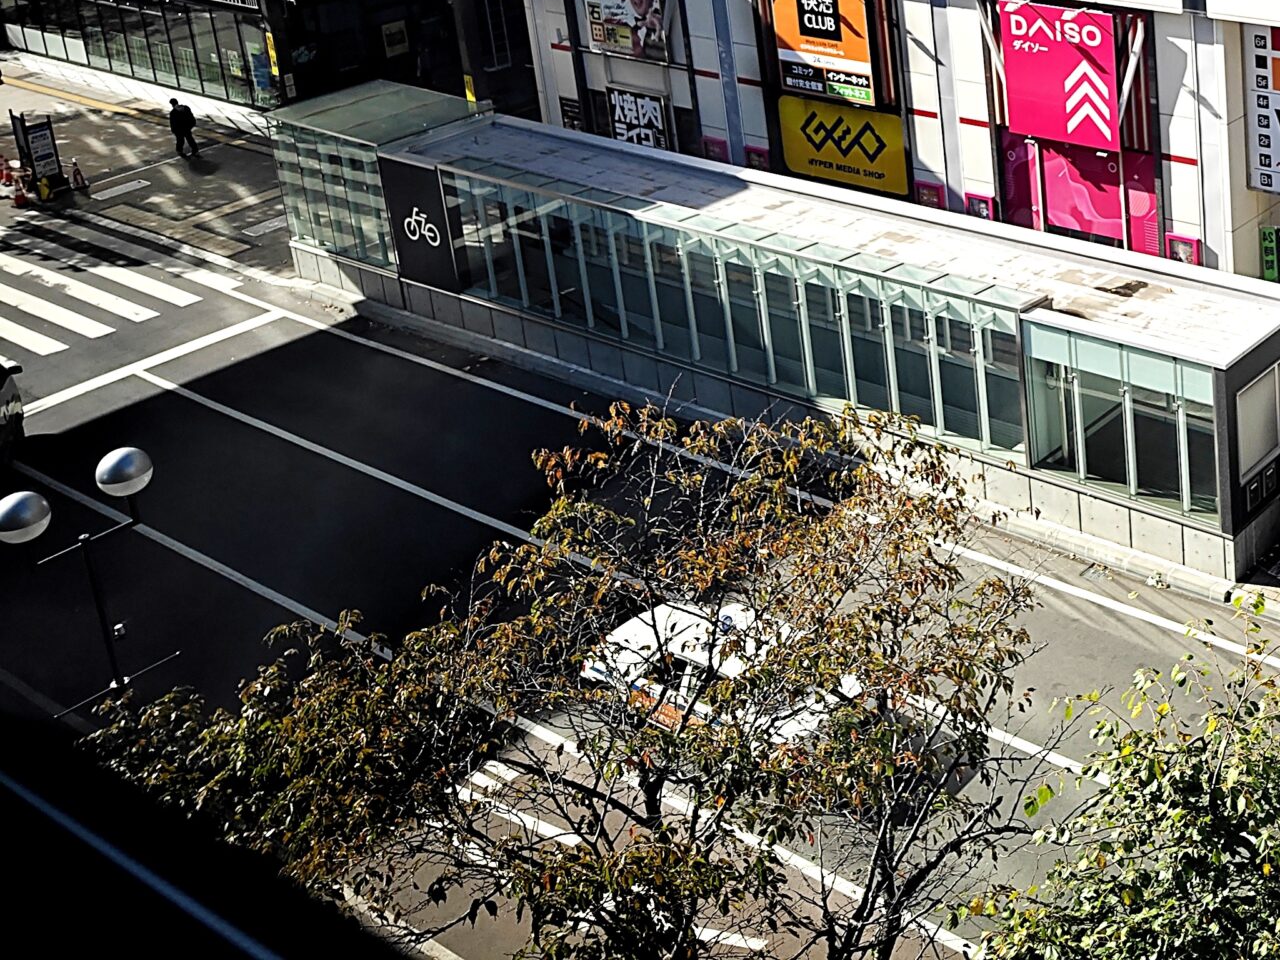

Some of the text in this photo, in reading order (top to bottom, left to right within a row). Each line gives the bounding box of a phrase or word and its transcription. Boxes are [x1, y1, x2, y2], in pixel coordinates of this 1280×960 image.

[803, 13, 836, 31] CLUB
[1009, 13, 1103, 48] DAISO
[1011, 38, 1049, 55] ダイソー
[611, 90, 664, 130] 焼肉
[808, 158, 886, 180] HYPER MEDIA SHOP
